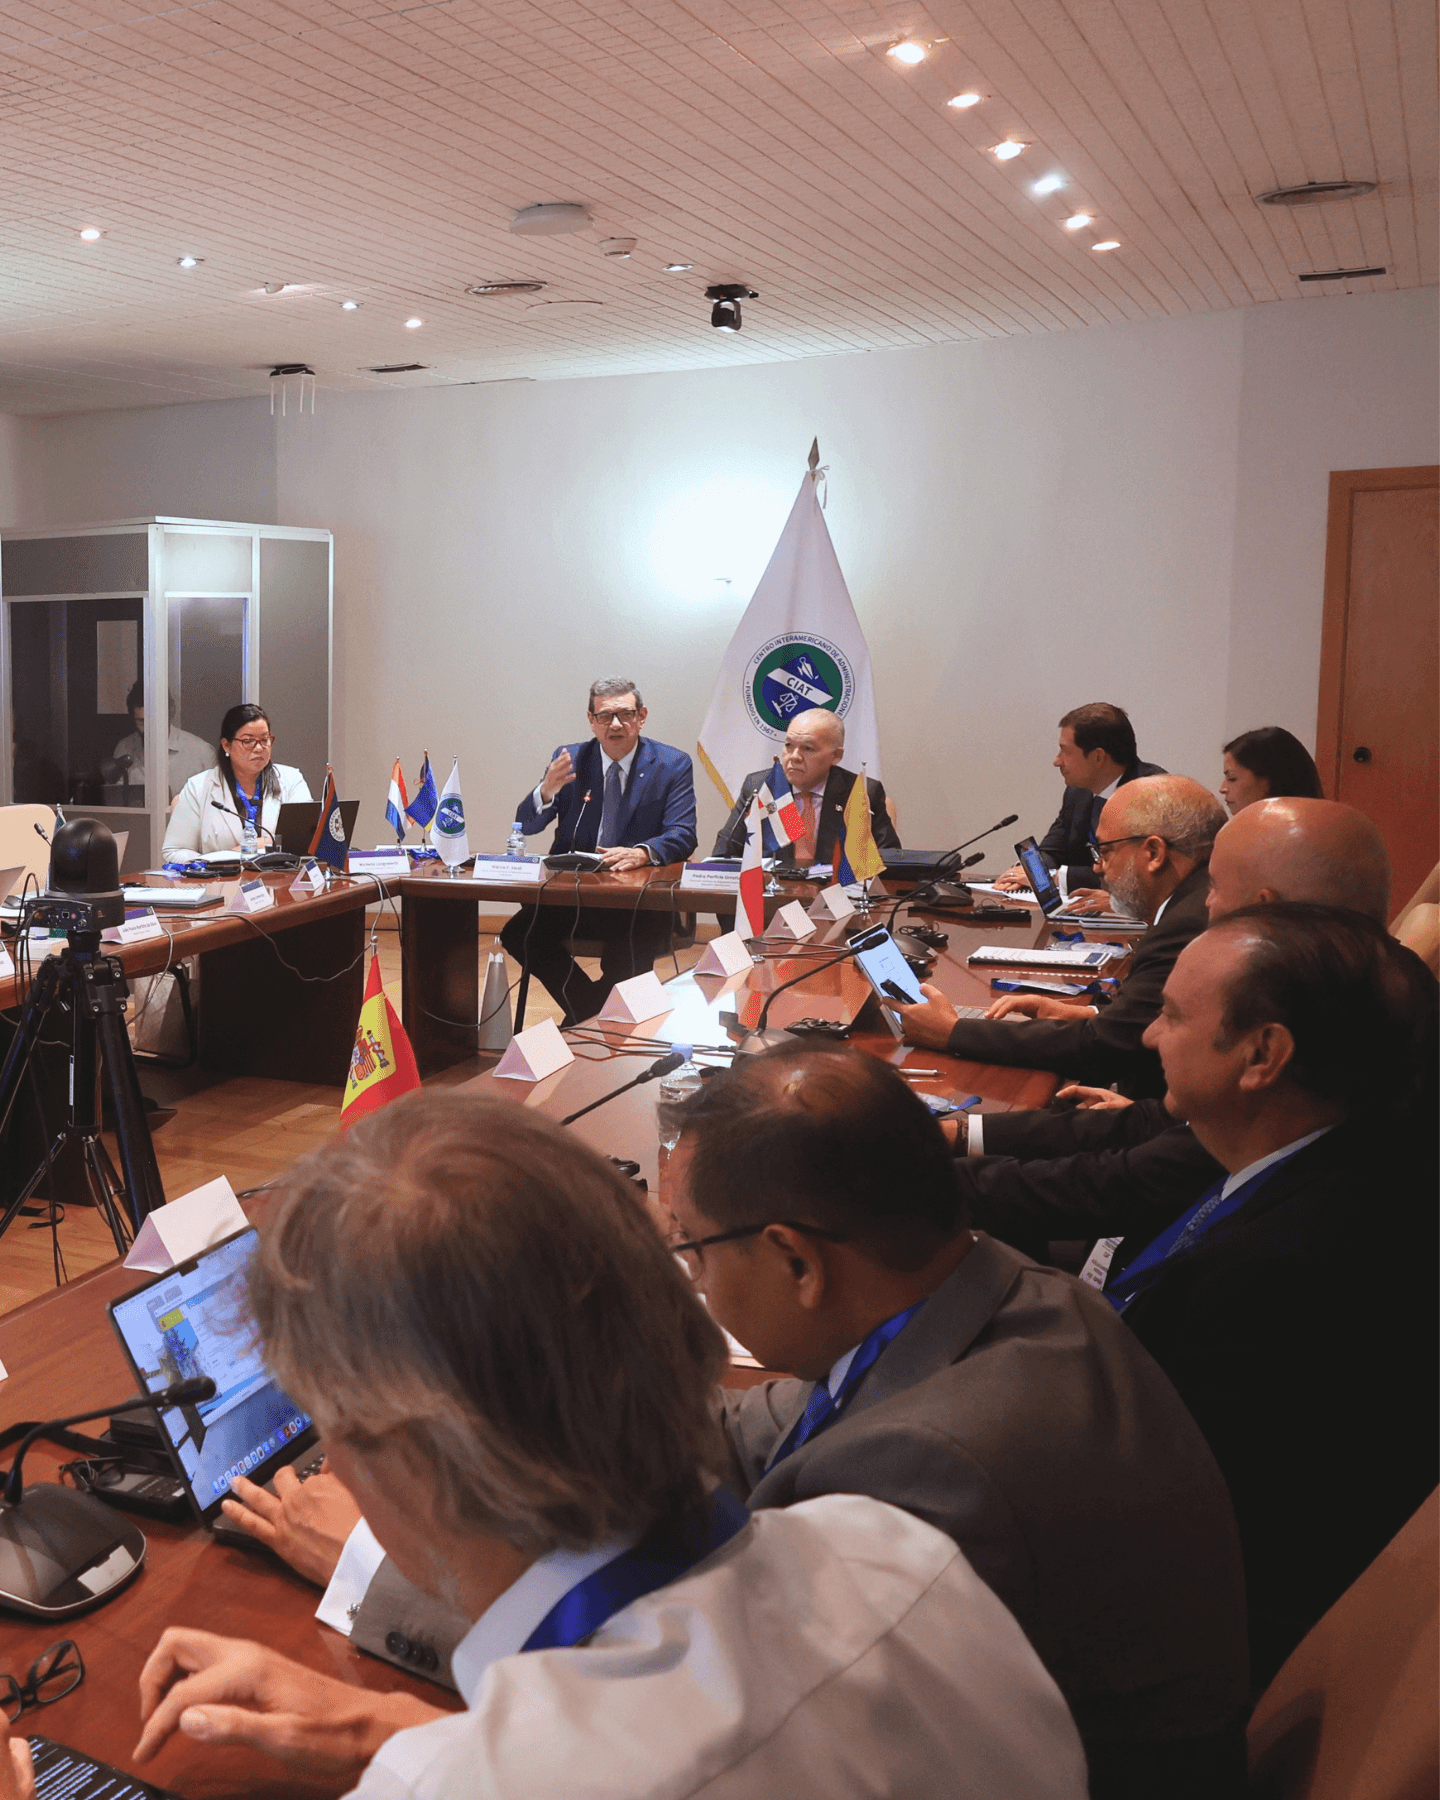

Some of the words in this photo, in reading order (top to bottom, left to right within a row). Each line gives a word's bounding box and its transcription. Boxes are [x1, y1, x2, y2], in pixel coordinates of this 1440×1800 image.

[753, 642, 775, 664] CENTRO
[774, 634, 832, 652] INTERAMERICANO
[830, 649, 839, 659] DE
[837, 657, 852, 718] ADMINISTRACIONE
[786, 677, 813, 696] CIAT
[745, 685, 756, 717] FUNDADO
[753, 715, 761, 725] EN
[759, 723, 775, 735] 1967
